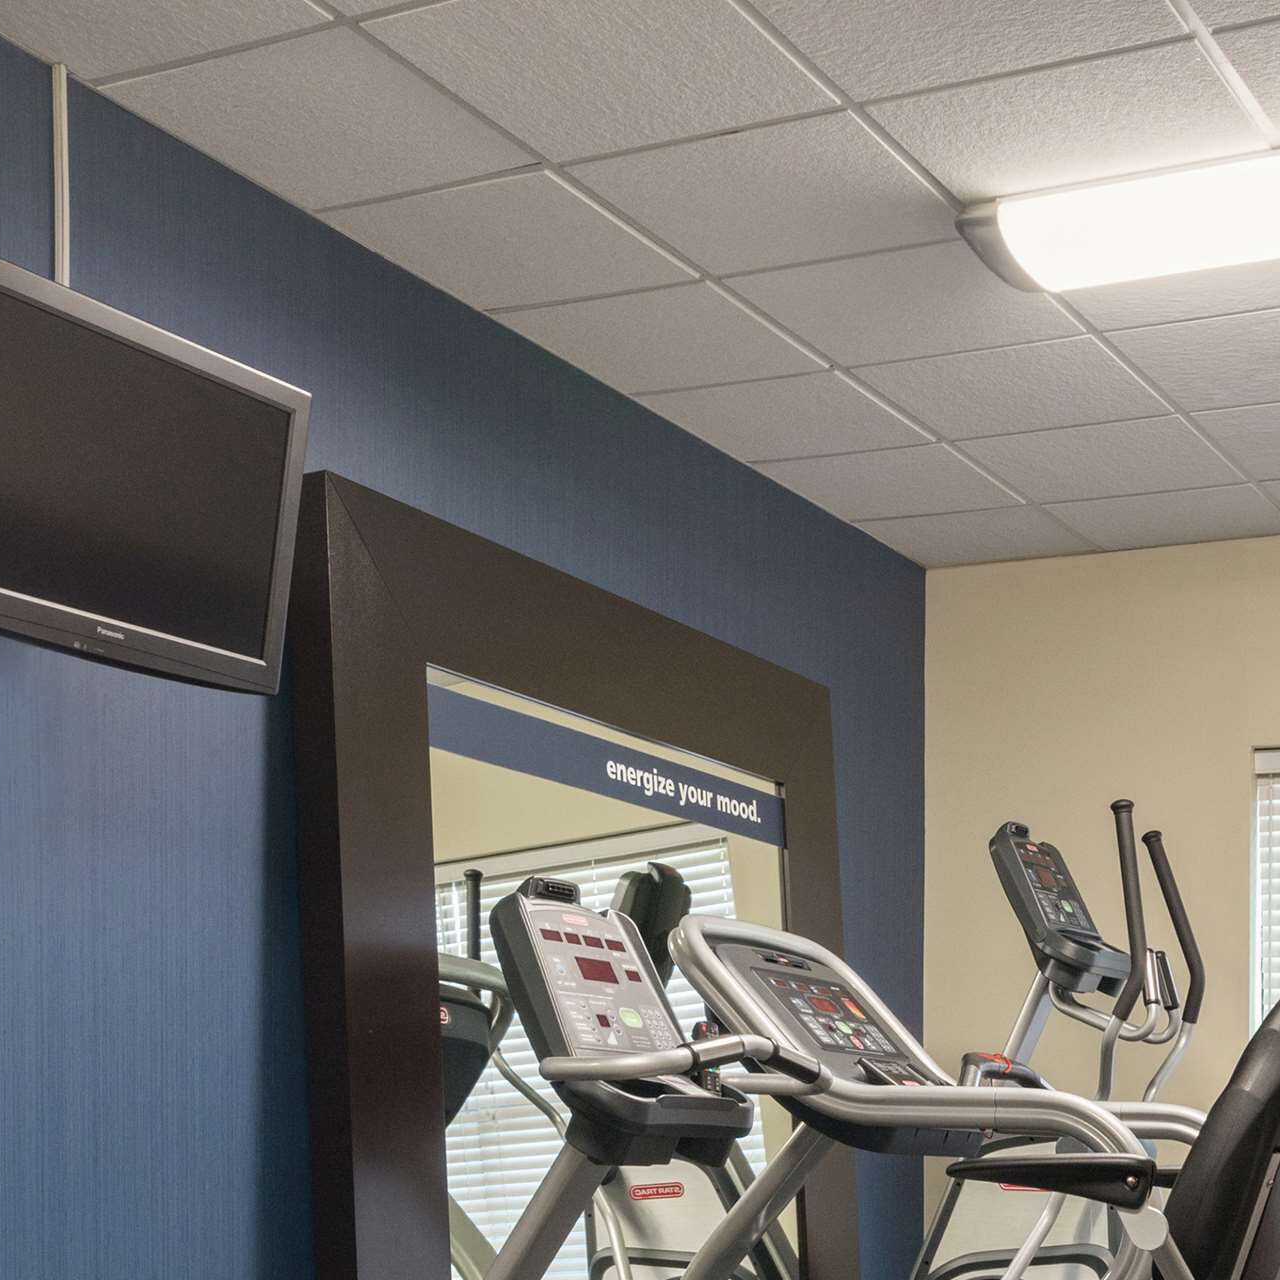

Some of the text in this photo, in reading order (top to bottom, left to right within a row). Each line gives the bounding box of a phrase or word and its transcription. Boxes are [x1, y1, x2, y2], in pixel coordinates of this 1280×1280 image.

[606, 758, 762, 824] energize your mood.
